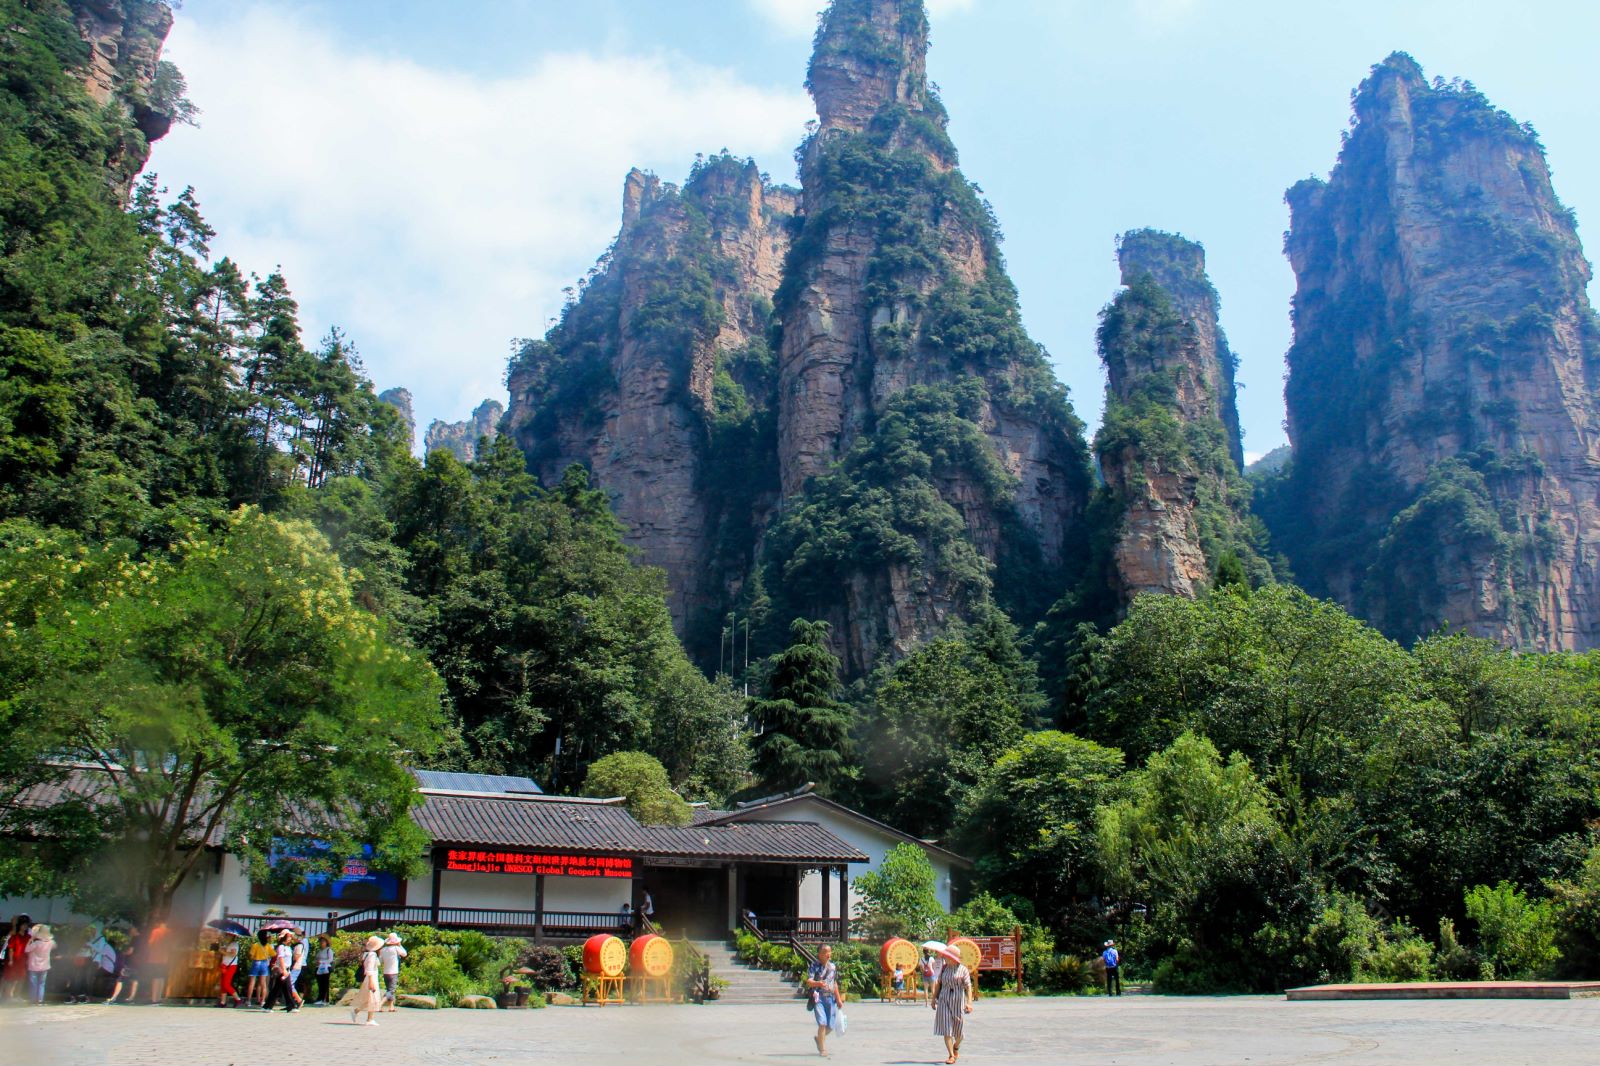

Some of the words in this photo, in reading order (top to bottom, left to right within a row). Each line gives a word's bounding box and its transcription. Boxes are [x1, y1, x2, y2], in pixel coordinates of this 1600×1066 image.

[447, 861, 501, 872] Zhangjiajie
[504, 864, 533, 873] UNESCO
[536, 866, 564, 875] Global
[568, 867, 600, 876] Geopark
[604, 869, 632, 878] Museum
